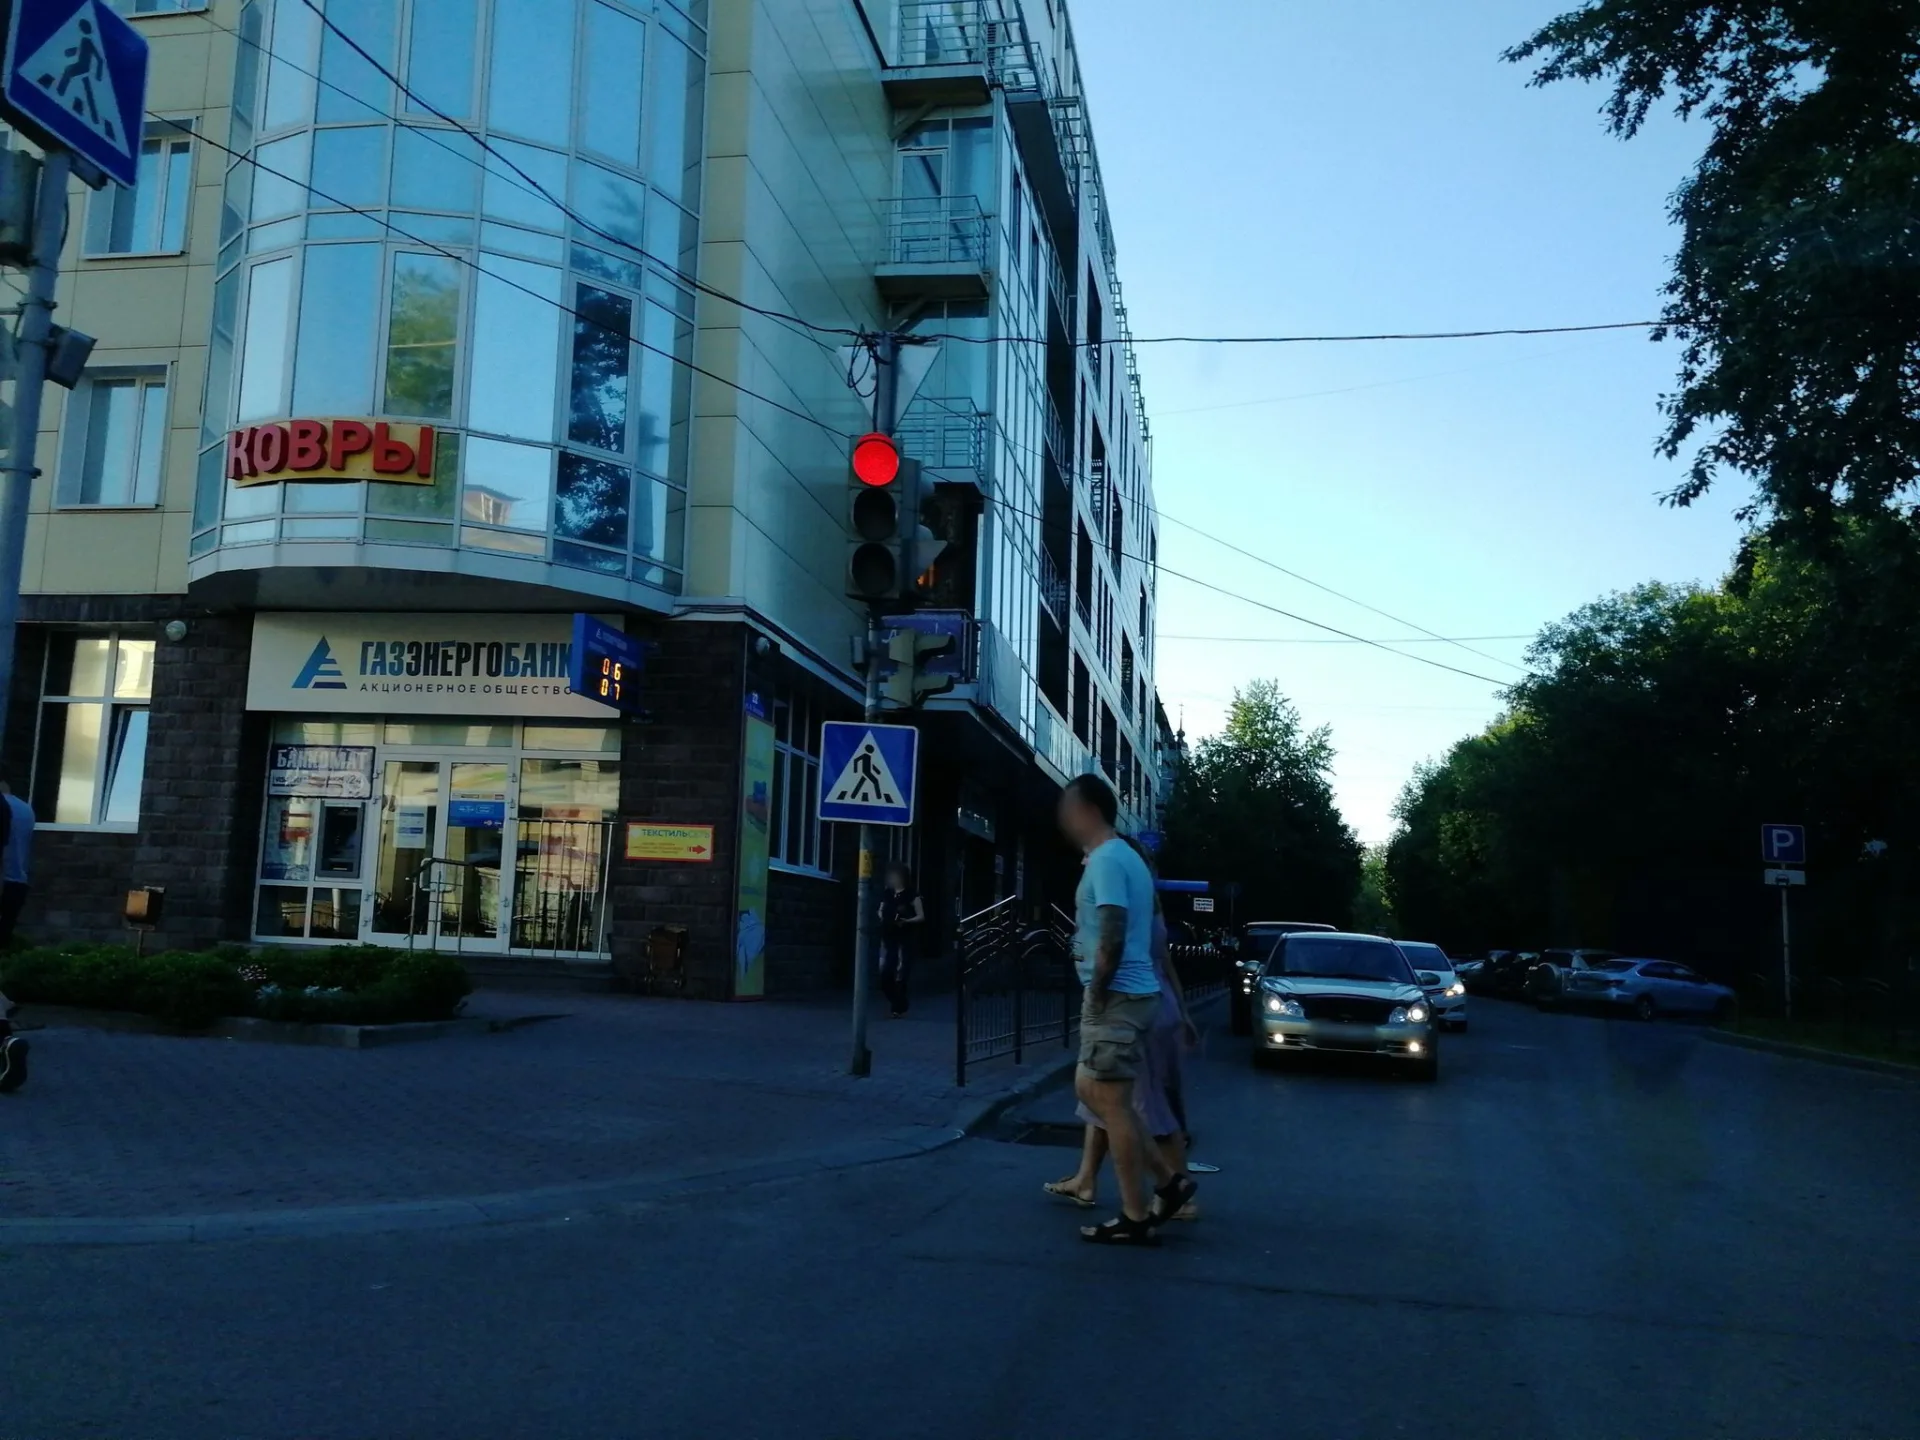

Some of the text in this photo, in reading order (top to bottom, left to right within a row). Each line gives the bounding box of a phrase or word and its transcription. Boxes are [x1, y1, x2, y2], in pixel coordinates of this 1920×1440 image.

[227, 420, 433, 479] КОВРЫ
[359, 640, 572, 677] ГАЗЭНЕРГОБАНК
[360, 683, 572, 695] АКЦИОНЕРНОЕ ОБЩЕСТВО
[642, 829, 688, 837] ТЕКСТИЛЬ
